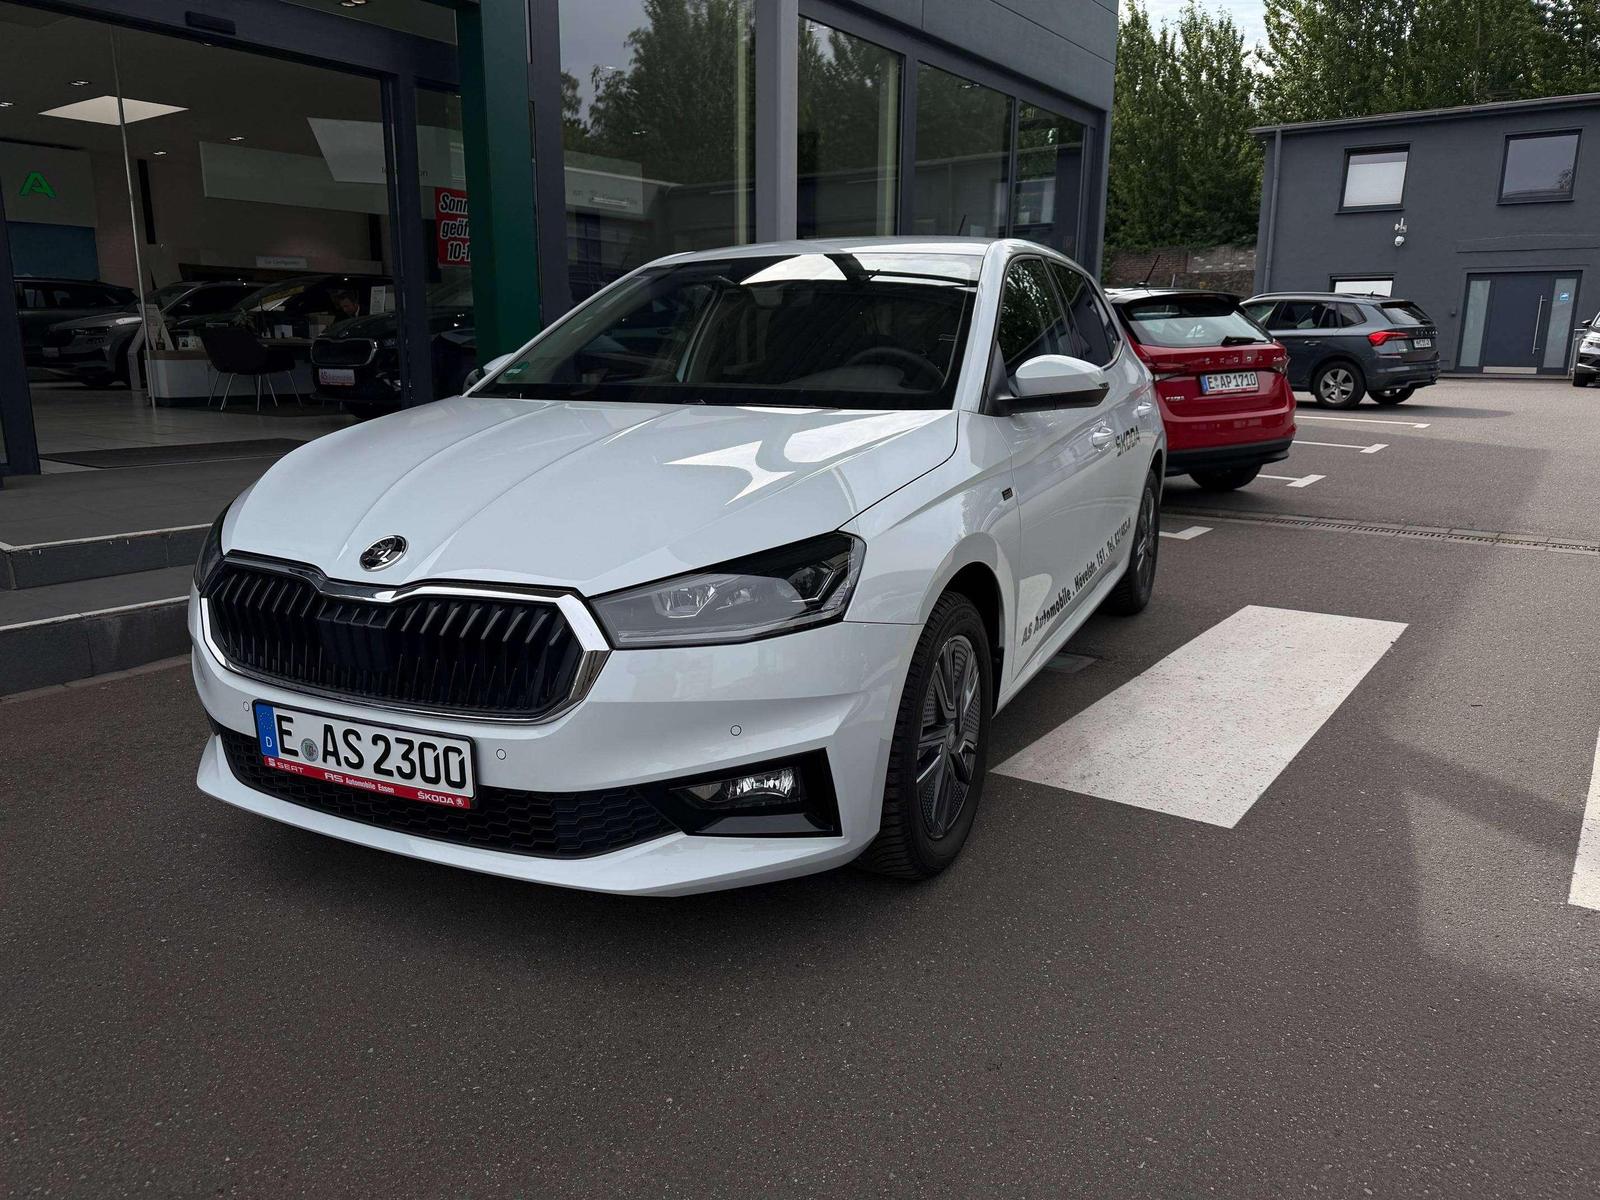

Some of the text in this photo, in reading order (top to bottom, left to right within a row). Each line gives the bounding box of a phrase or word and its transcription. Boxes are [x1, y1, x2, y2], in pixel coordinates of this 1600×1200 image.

[1021, 622, 1033, 646] AS
[1033, 587, 1072, 635] Automobile
[265, 736, 273, 748] D
[276, 714, 299, 757] E
[371, 733, 467, 790] 2300
[276, 761, 304, 773] SEAT
[324, 772, 344, 783] AS
[345, 777, 376, 790] Automobile
[377, 784, 395, 794] Essen
